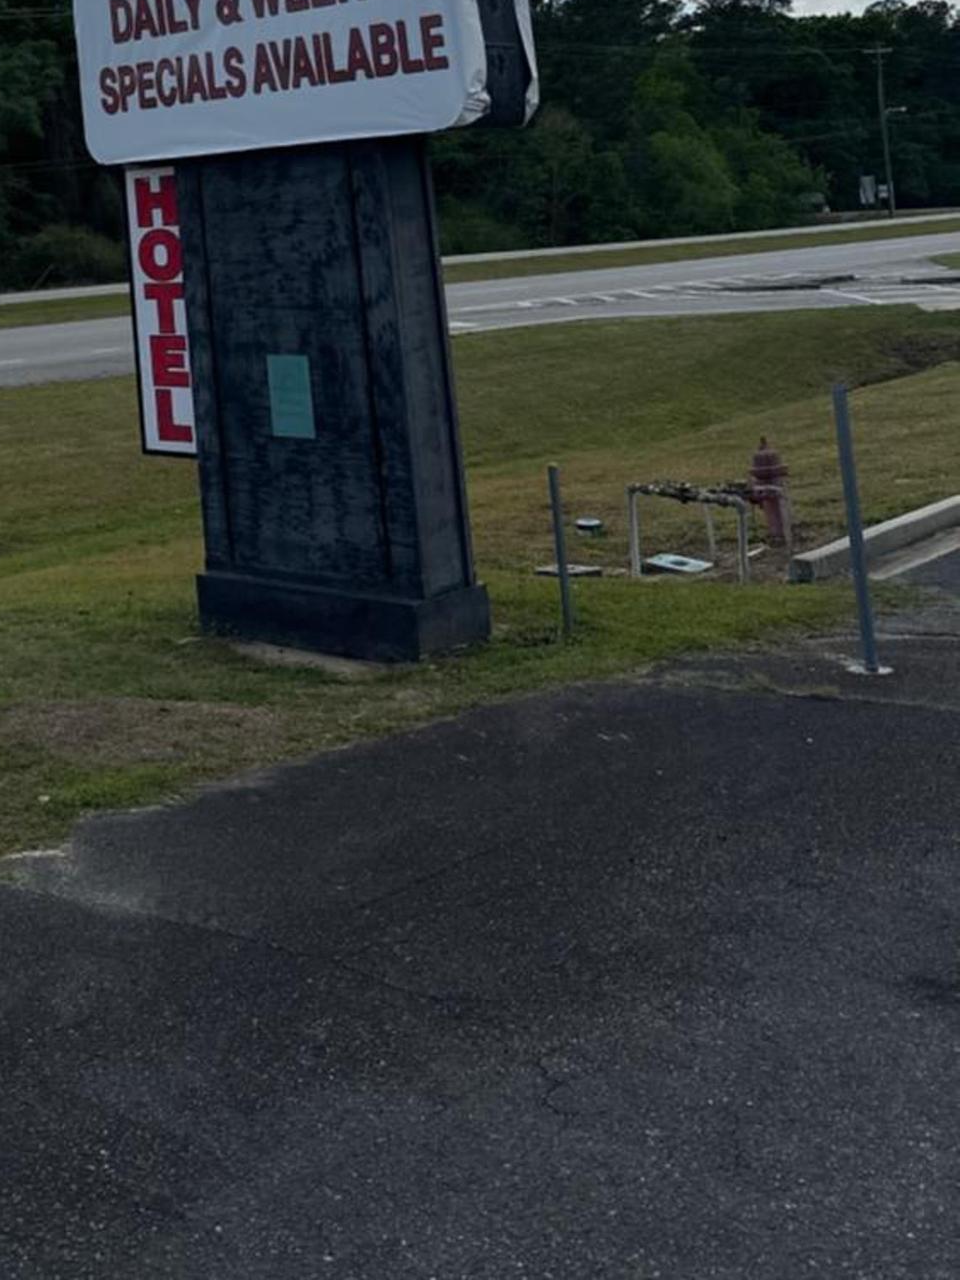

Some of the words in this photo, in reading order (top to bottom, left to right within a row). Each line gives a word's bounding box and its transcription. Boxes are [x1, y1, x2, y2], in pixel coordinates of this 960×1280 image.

[99, 46, 246, 114] SPECIALS
[253, 14, 449, 94] AVAILABLE
[134, 175, 194, 443] HOTEL
